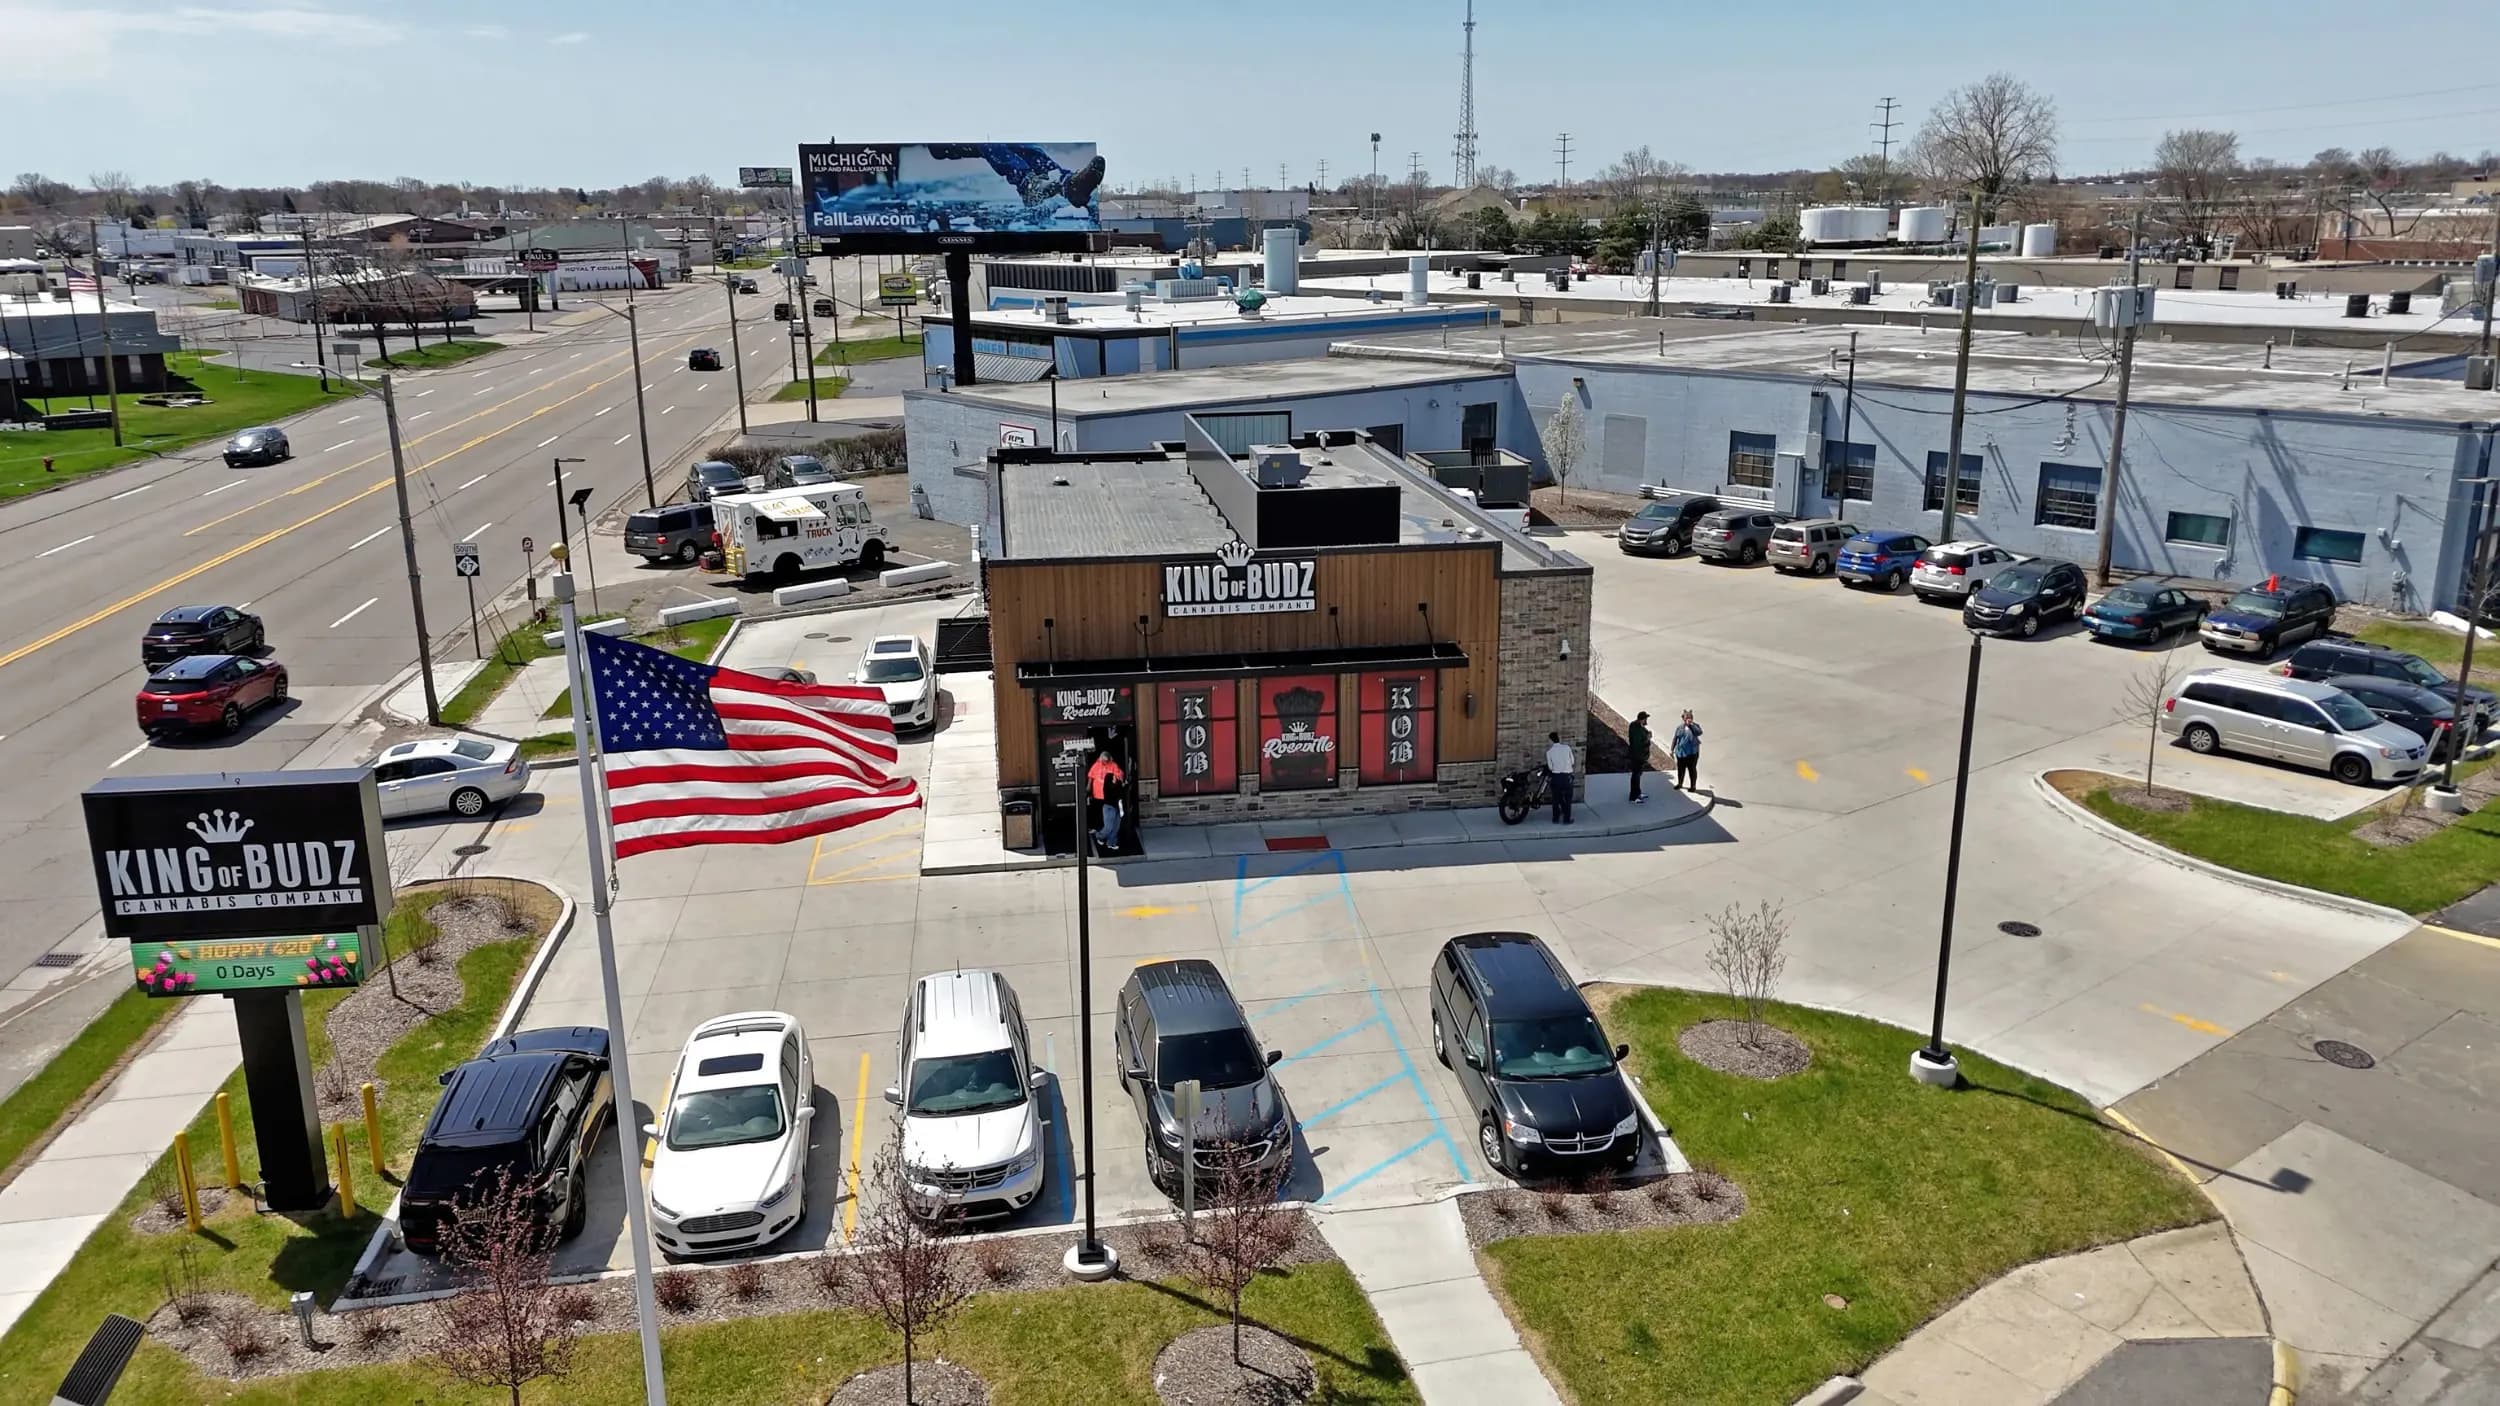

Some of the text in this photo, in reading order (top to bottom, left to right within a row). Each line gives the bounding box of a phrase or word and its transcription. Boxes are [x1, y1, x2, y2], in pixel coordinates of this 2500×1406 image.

[813, 211, 916, 227] FallLaw.com
[806, 527, 832, 539] TRUCK
[456, 545, 476, 553] SOUTH
[461, 563, 474, 571] 97
[1166, 562, 1315, 602] KING OF BUDZ
[1173, 601, 1311, 615] CANNABIS COMPANY
[1057, 690, 1081, 706] KING
[1087, 688, 1115, 706] BUDZ
[1062, 704, 1111, 720] Roseville
[1262, 736, 1336, 759] Roseville
[106, 840, 361, 896] KING OF BUDZ
[123, 889, 356, 913] CANNABIS COMPANY
[198, 941, 312, 961] HOPPY 420
[233, 964, 275, 980] Days
